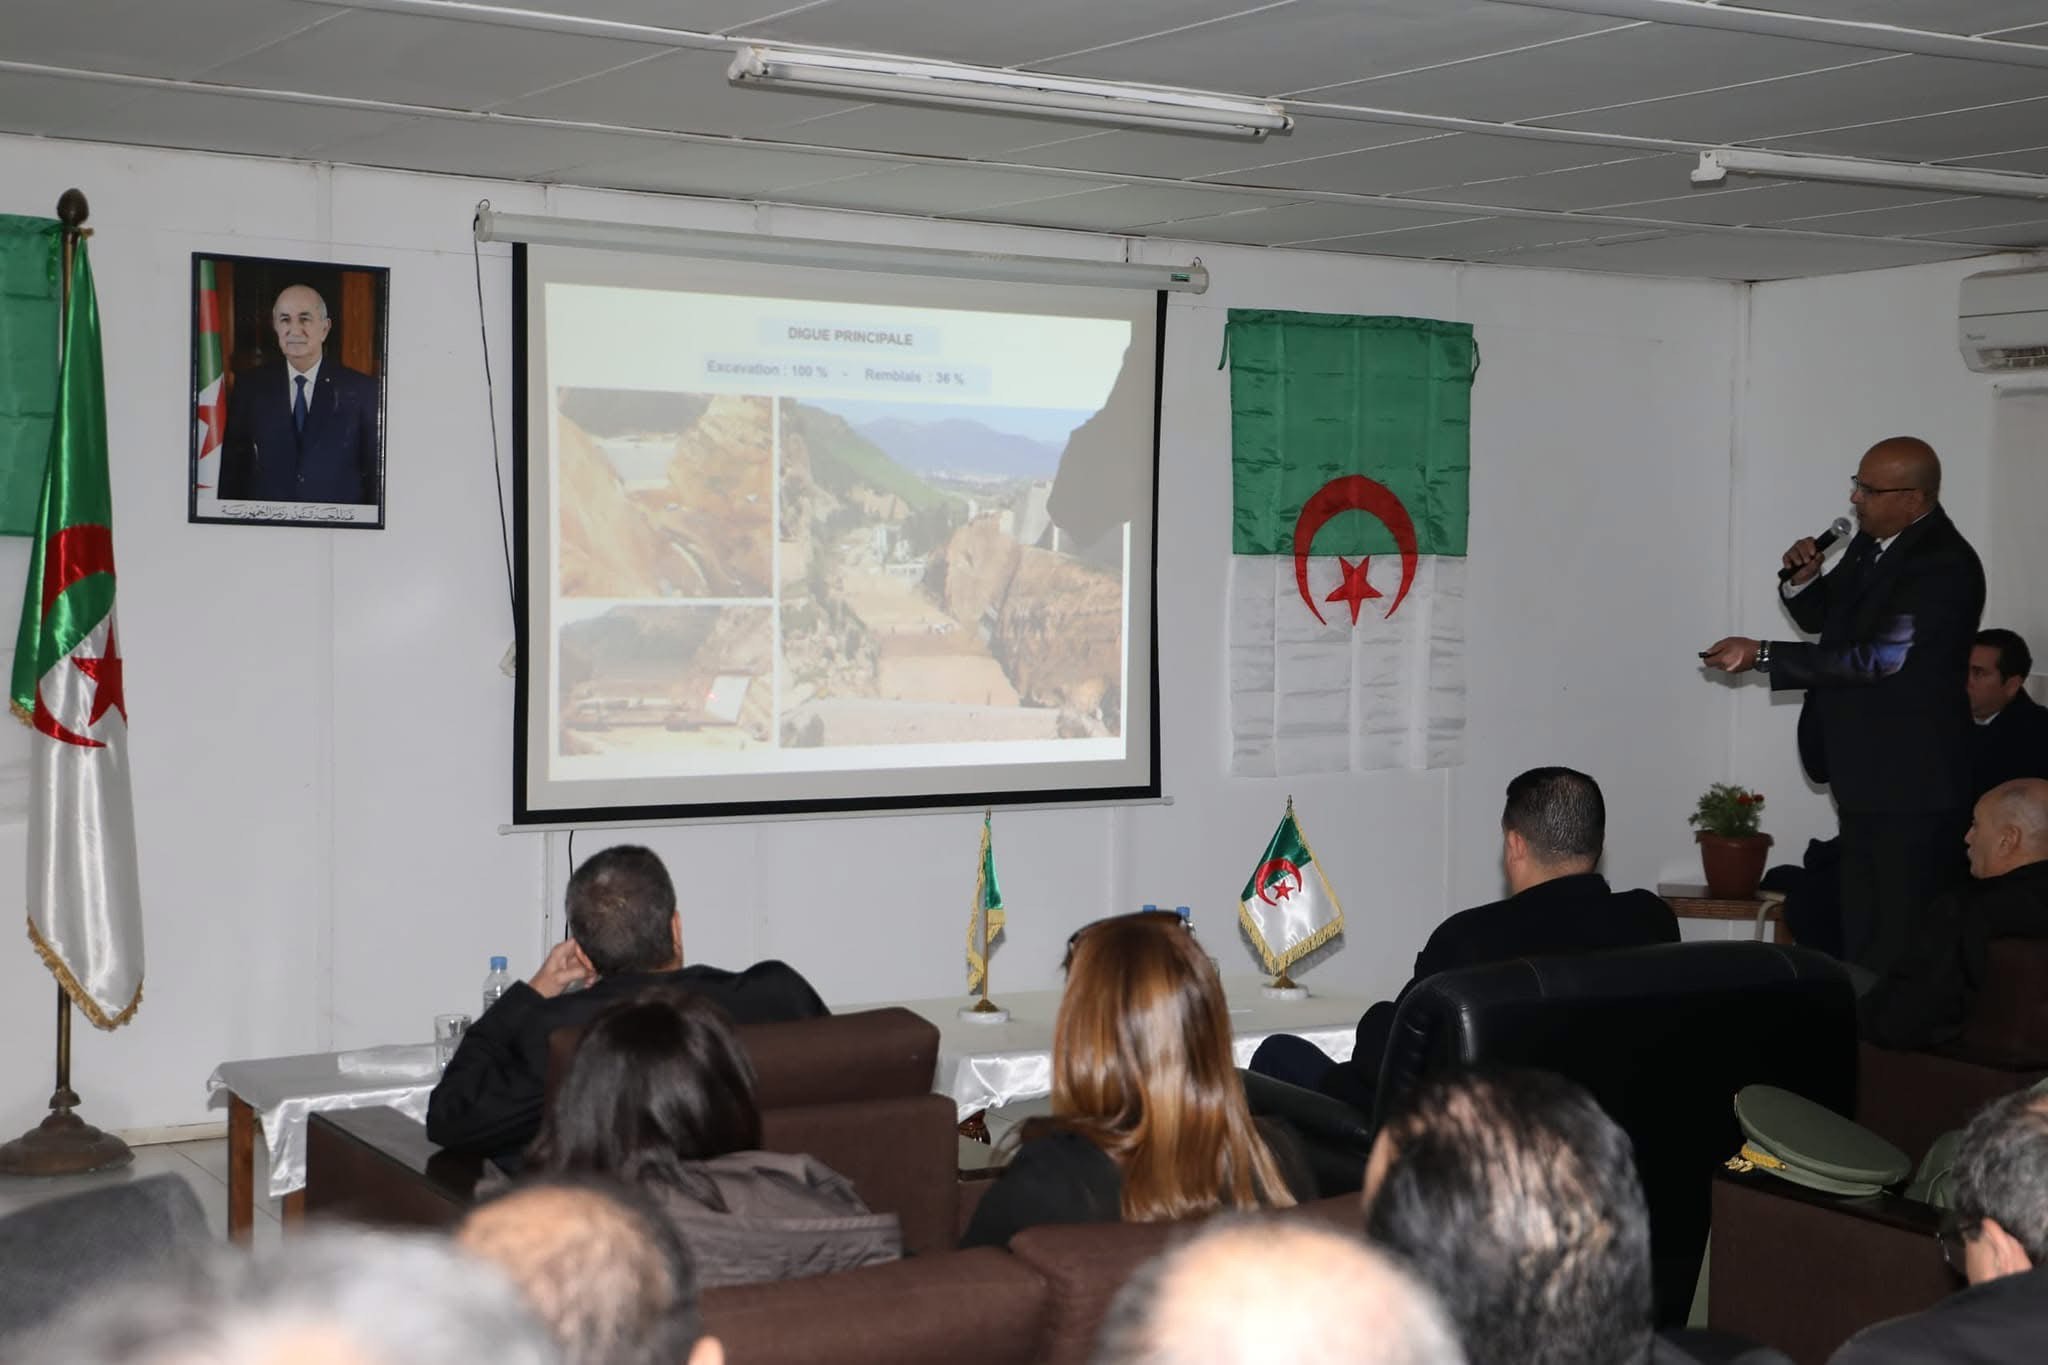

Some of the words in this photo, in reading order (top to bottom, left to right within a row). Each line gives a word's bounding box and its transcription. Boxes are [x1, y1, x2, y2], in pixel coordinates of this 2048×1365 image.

[788, 326, 831, 341] DIGUE
[834, 329, 913, 346] PRINCIPALE
[706, 359, 780, 375] Excavation
[792, 364, 813, 377] 100
[815, 365, 828, 378] %
[864, 367, 922, 383] Remblais
